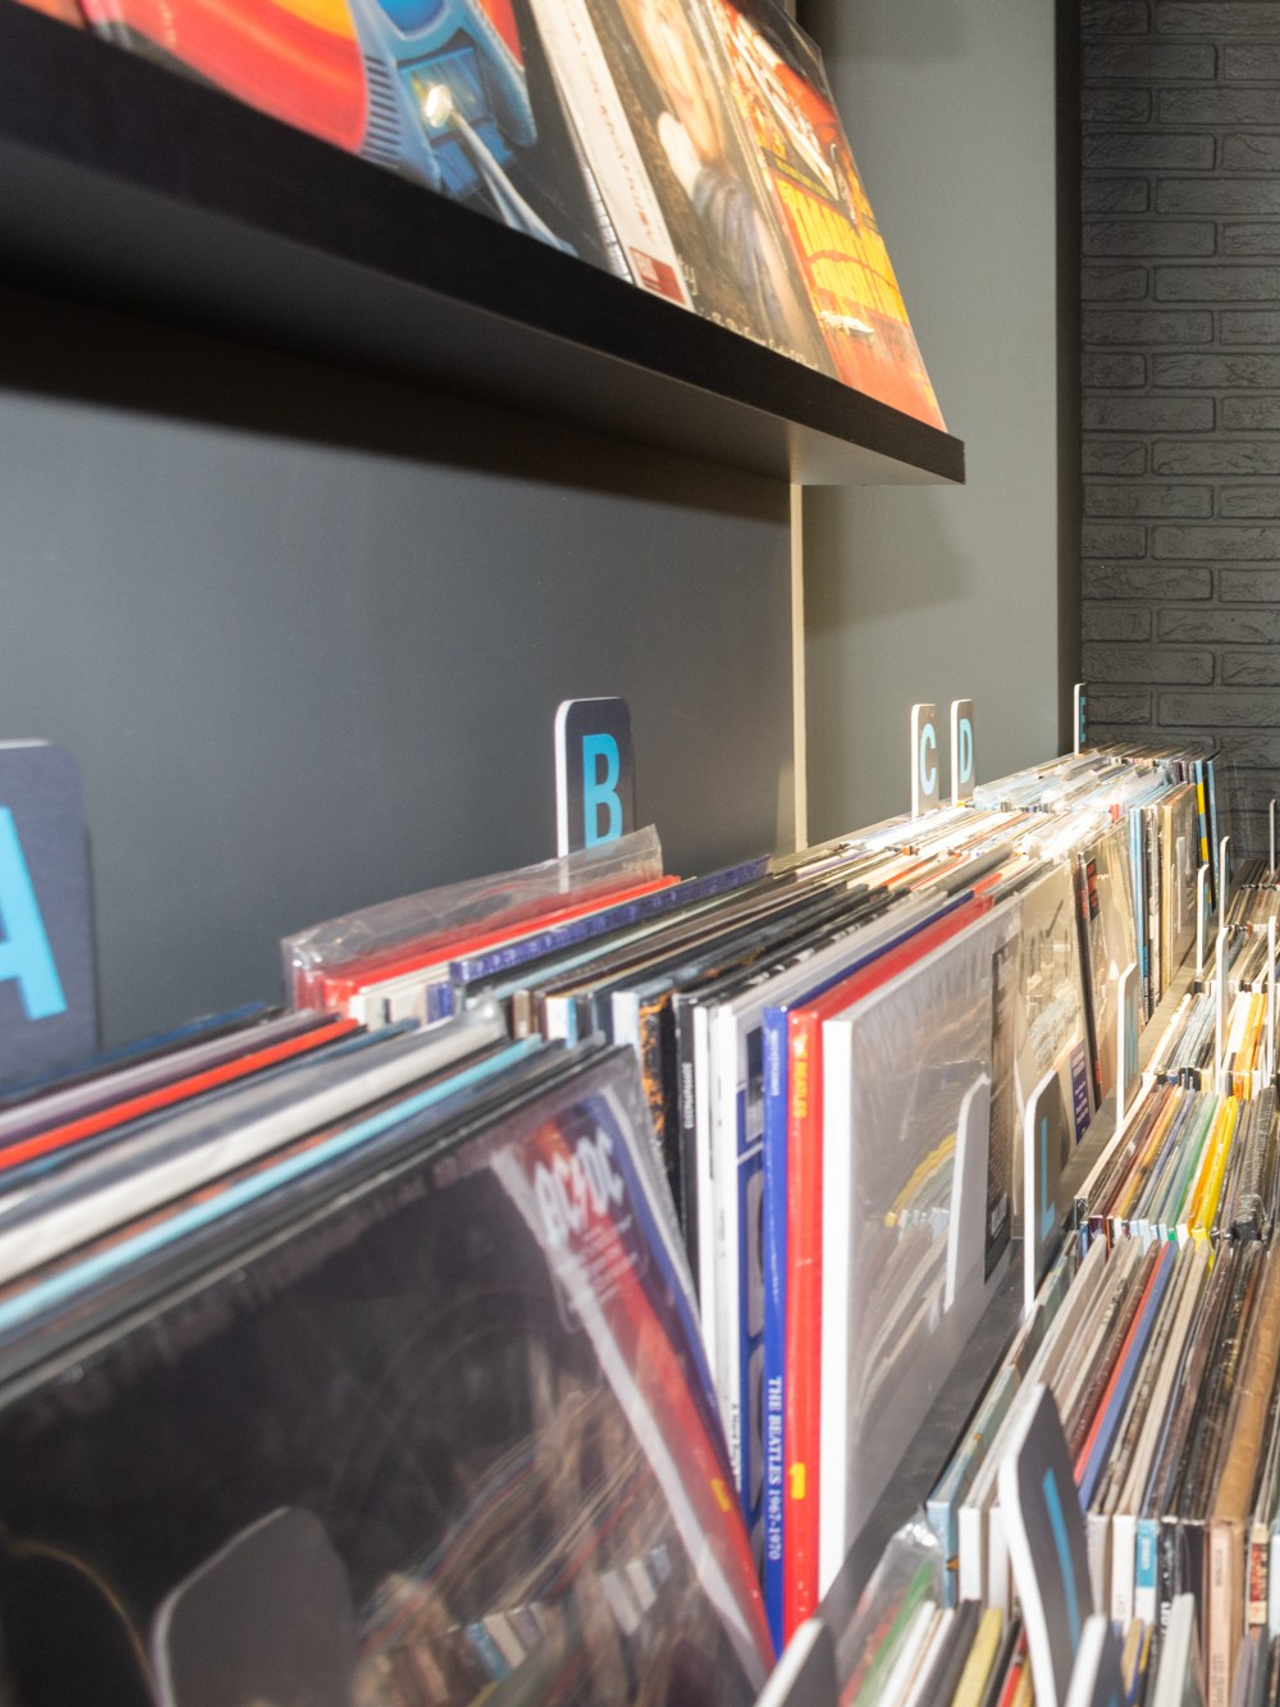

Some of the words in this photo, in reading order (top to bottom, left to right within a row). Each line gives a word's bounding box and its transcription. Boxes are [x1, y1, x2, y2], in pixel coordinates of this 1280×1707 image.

[920, 723, 937, 796] C
[959, 718, 973, 785] D
[582, 733, 623, 862] B
[768, 1375, 782, 1411] THE
[768, 1414, 782, 1485] BEATLES
[788, 1462, 806, 1500] 1
[768, 1489, 782, 1560] 1967-1970
